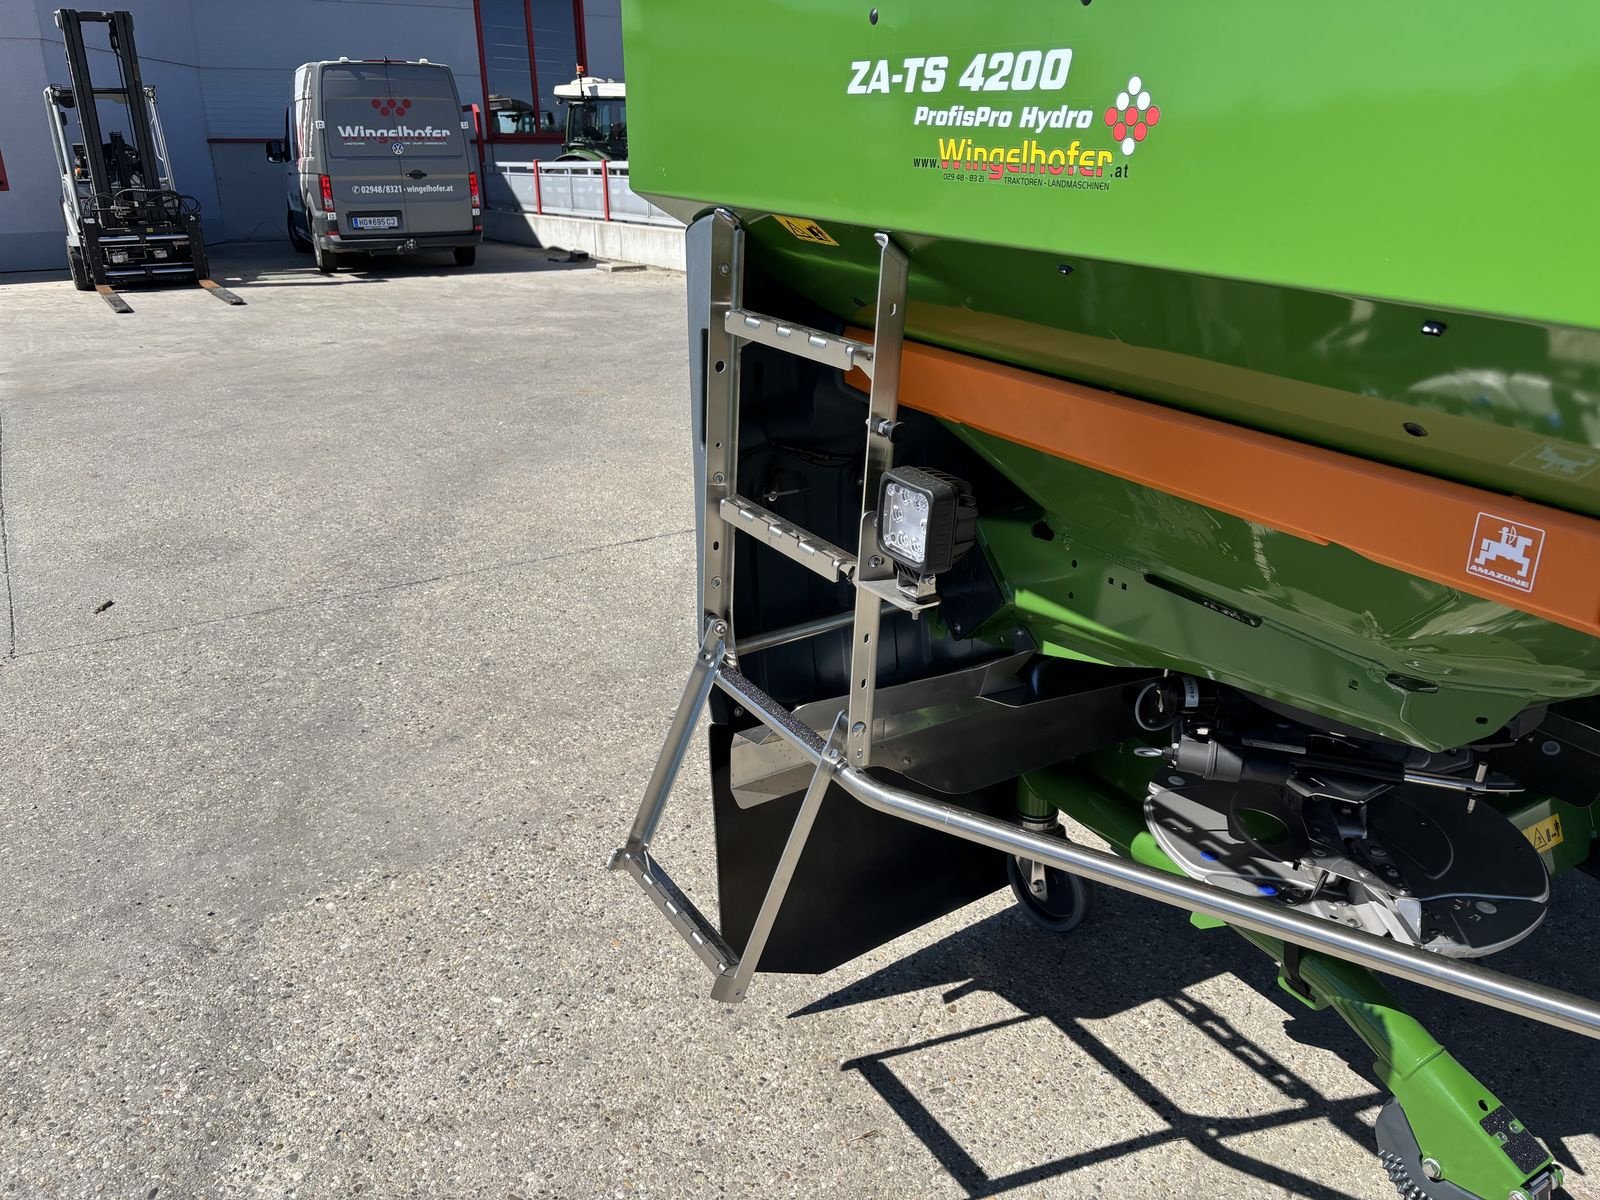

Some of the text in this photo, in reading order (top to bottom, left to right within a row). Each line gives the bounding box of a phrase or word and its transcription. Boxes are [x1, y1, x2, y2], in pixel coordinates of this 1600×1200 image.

[847, 48, 1073, 94] ZA-TS 4200
[914, 105, 1093, 134] ProfisPro Hydro
[337, 125, 451, 143] Wingelhofer
[360, 184, 454, 194] 02948/8321 wingelhofer.at
[1004, 176, 1043, 188] TRAKTOREN
[1047, 179, 1111, 191] LANDMASCHINEN
[1469, 564, 1530, 588] AMAZONE
